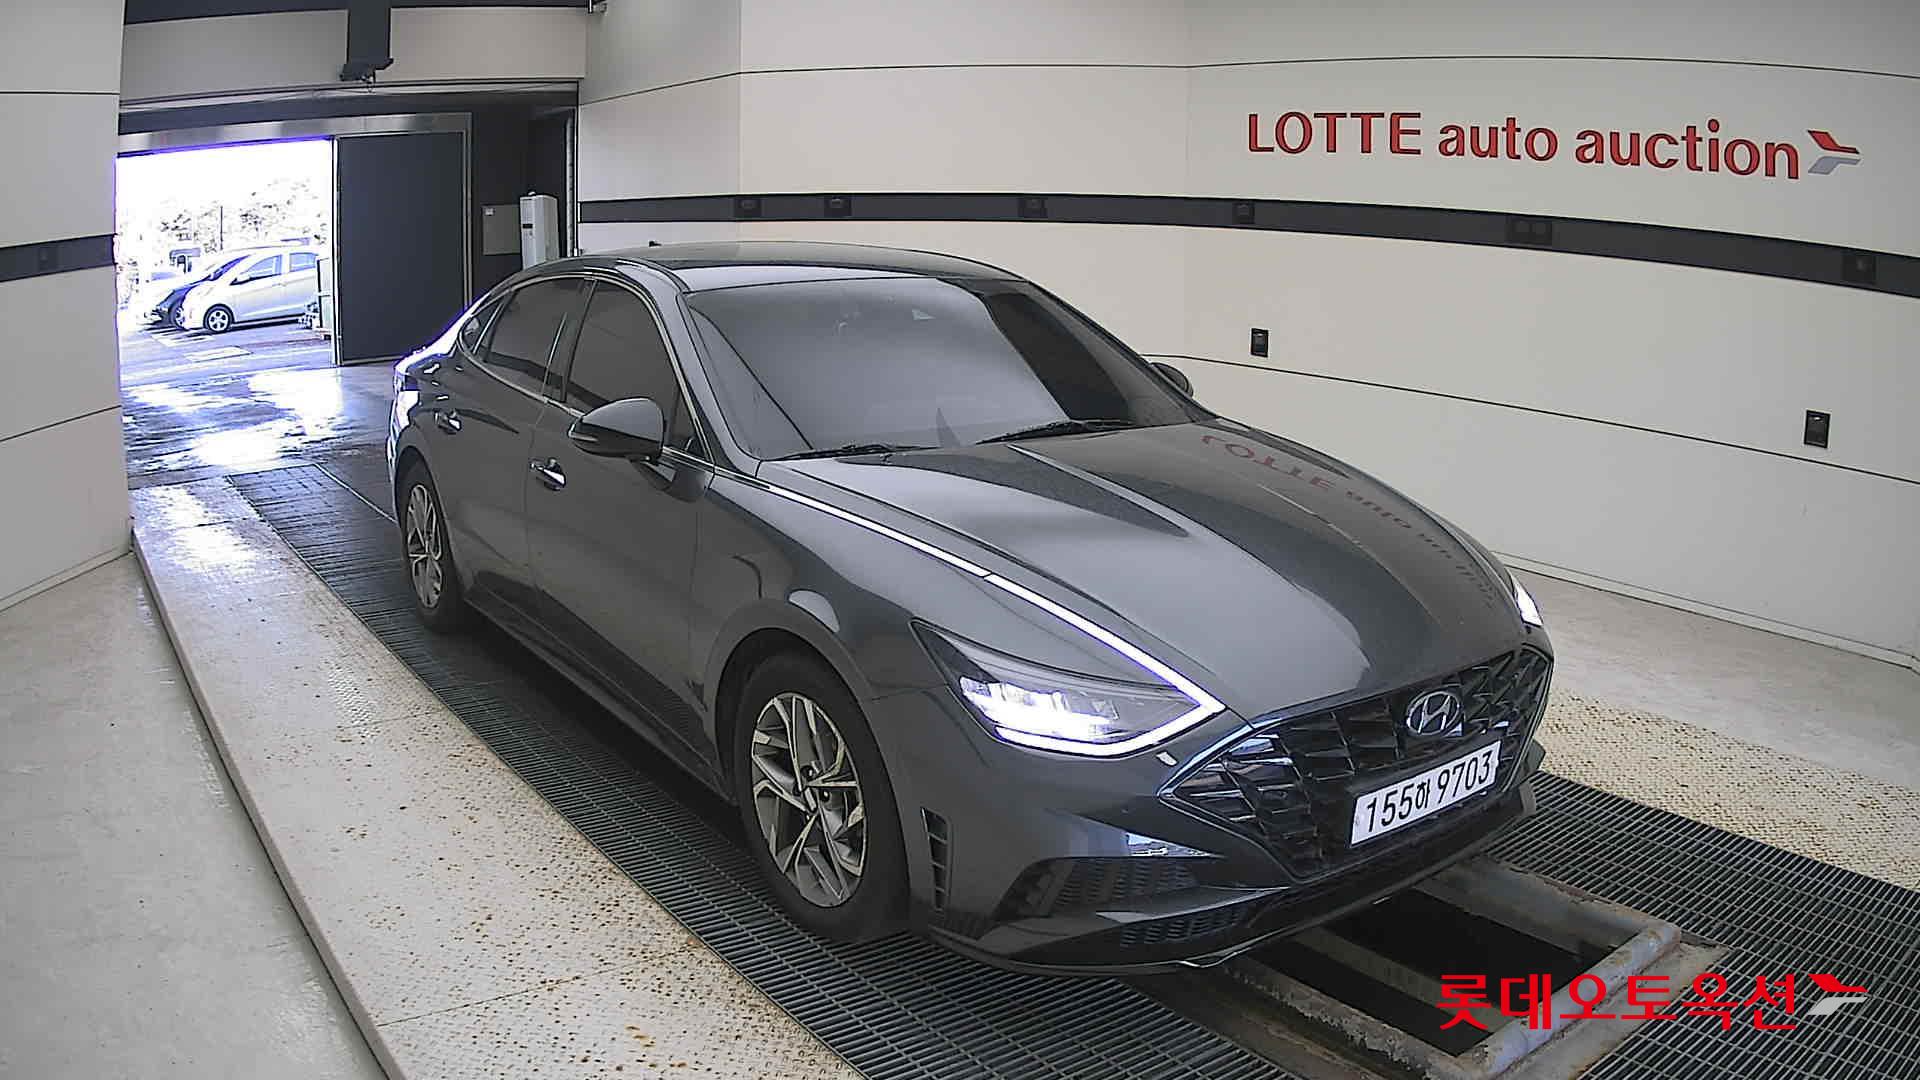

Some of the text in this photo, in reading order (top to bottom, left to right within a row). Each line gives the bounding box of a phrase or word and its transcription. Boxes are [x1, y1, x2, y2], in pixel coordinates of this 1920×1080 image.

[1248, 111, 1800, 179] LOTTE auto auction
[1366, 750, 1493, 833] 155하 9703
